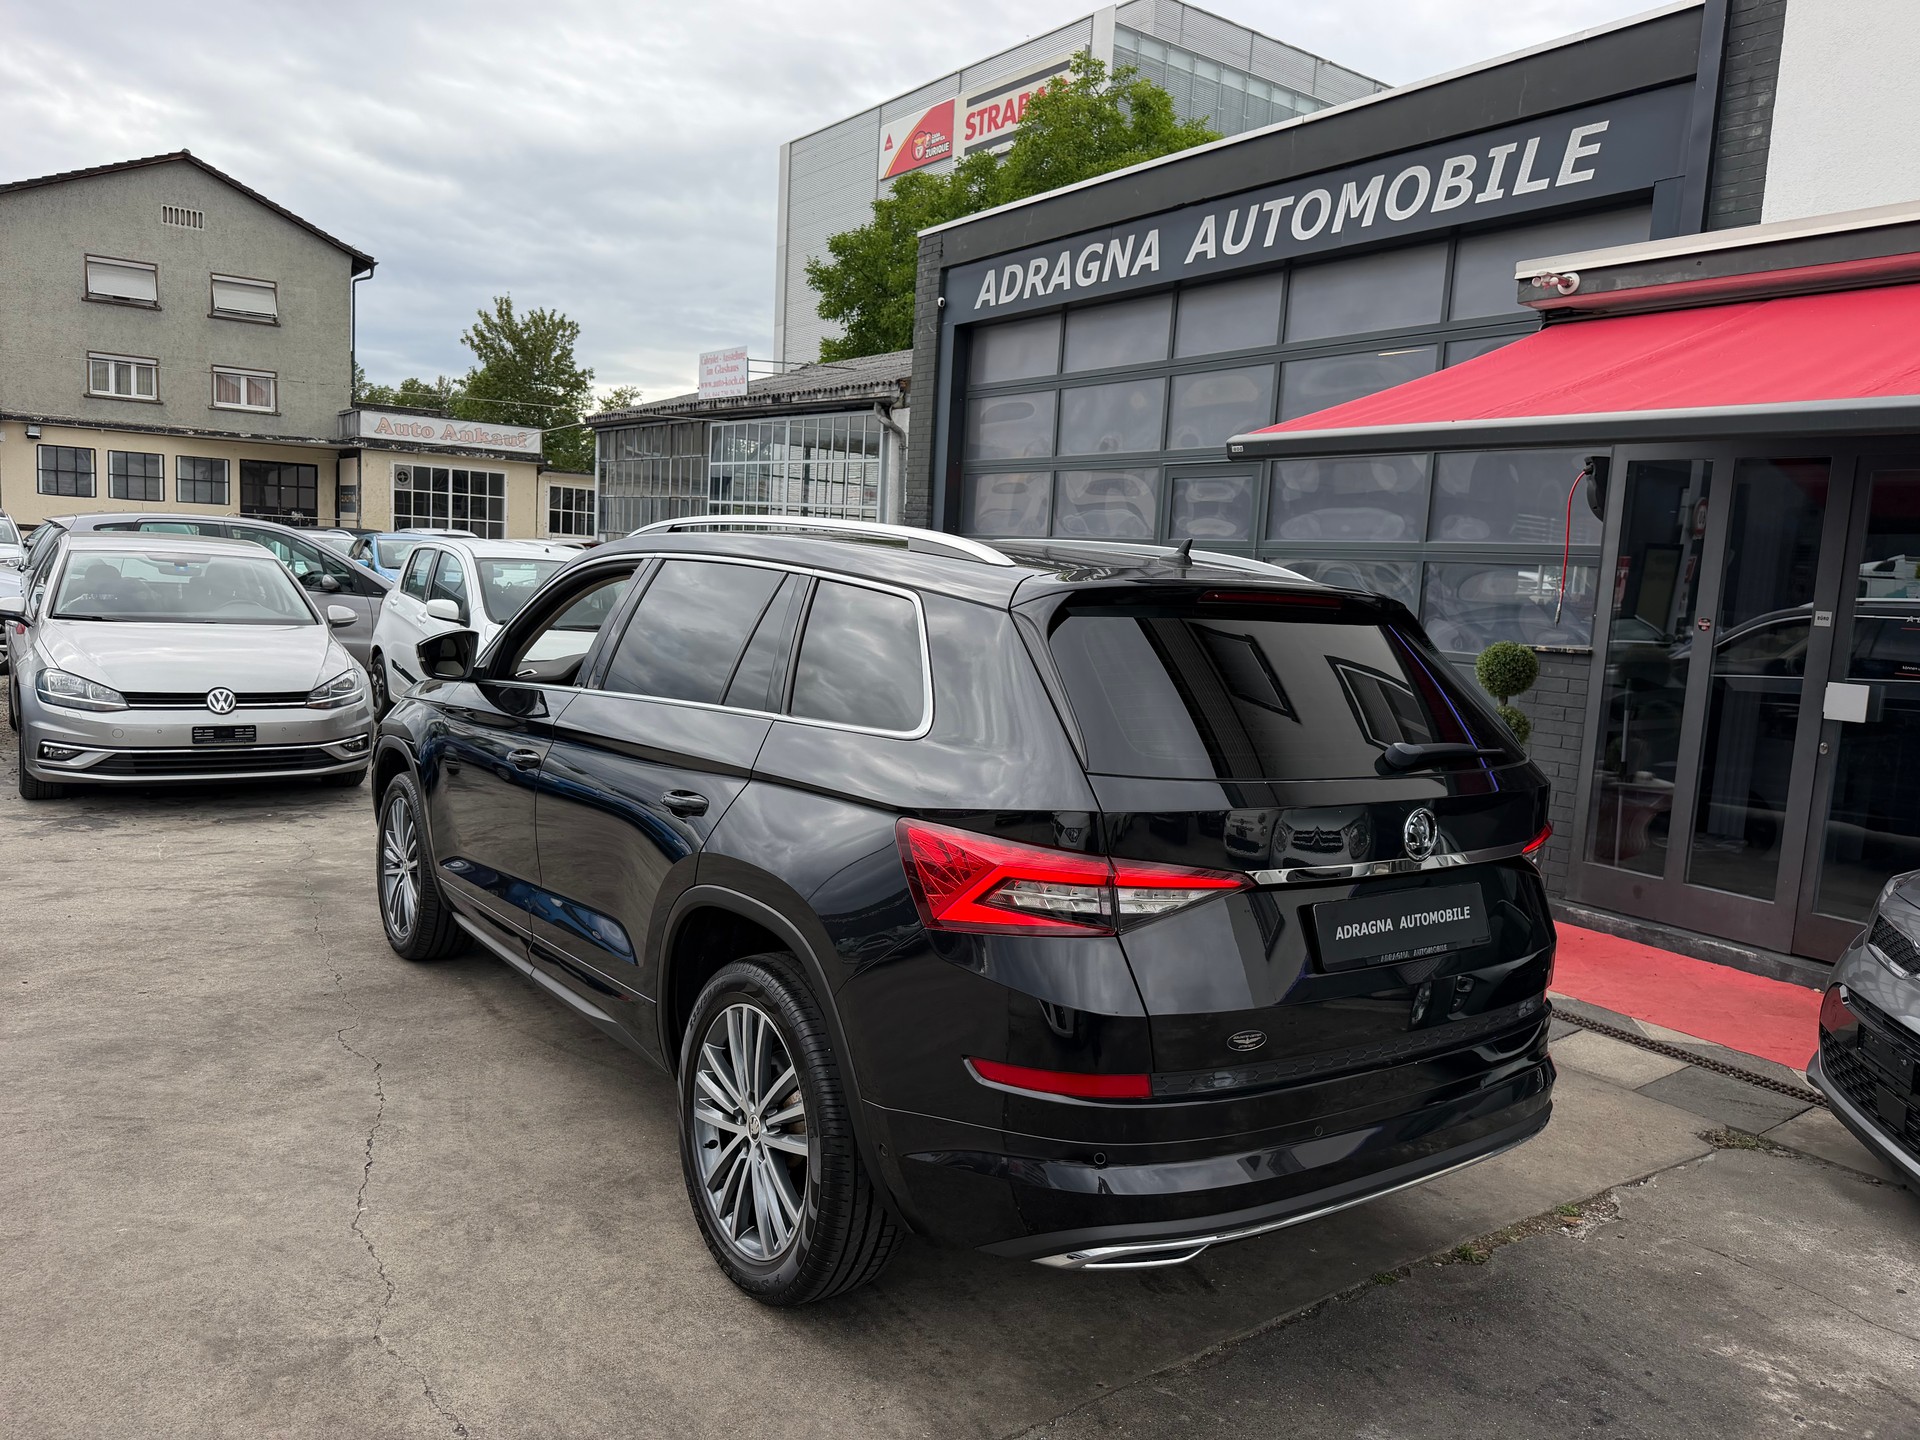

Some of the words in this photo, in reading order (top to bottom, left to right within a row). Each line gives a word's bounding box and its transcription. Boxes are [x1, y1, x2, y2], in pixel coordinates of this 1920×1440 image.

[974, 229, 1160, 309] ADRAGNA
[1184, 120, 1609, 264] AUTOMOBILE
[374, 416, 435, 438] Auto
[440, 424, 527, 448] Ankauf
[1336, 918, 1394, 940] ADRAGNA
[1400, 906, 1470, 929] AUTOMOBILE
